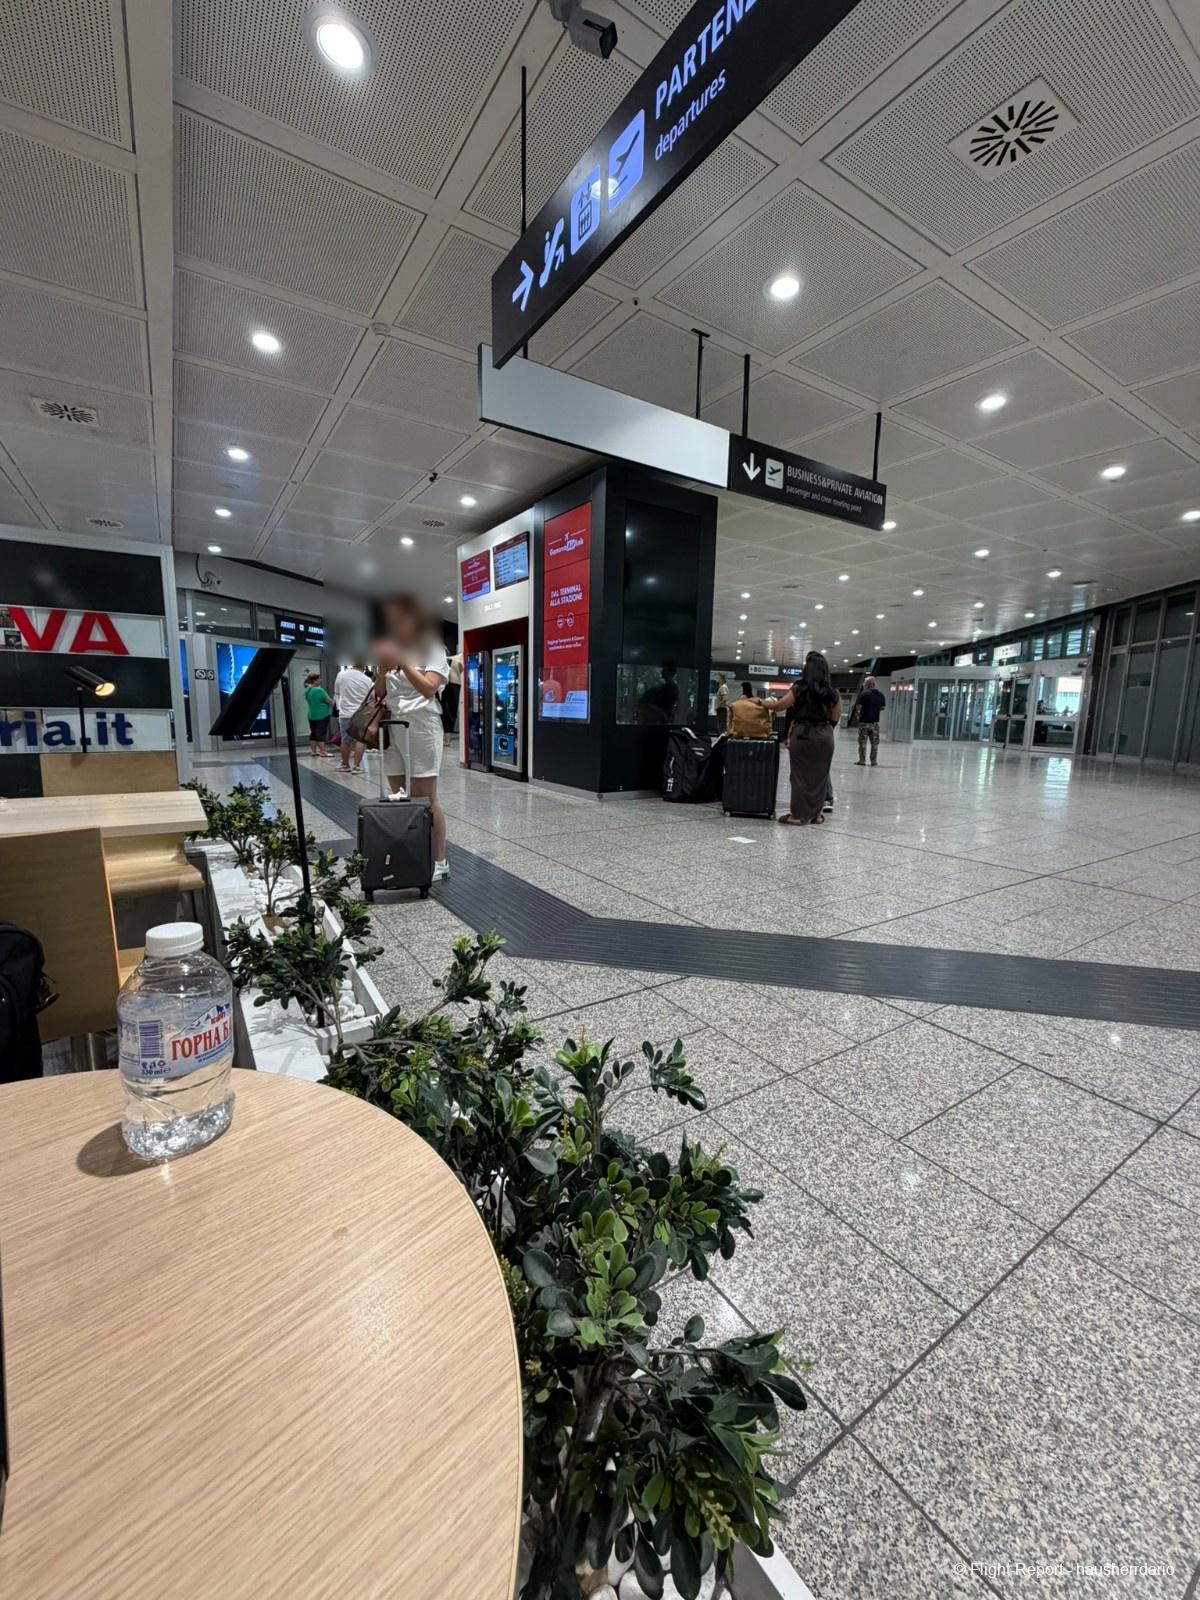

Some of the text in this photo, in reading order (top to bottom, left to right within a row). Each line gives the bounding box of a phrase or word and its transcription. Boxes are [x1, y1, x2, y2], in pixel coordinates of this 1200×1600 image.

[655, 69, 726, 161] departures
[787, 465, 883, 505] BUSINESS&PRIVATE AVIATION
[811, 492, 821, 501] and
[550, 592, 583, 607] ALLA STAZIONE
[560, 584, 581, 597] TERMINAL
[7, 606, 130, 655] VA
[0, 711, 134, 746] ria.it
[171, 1026, 221, 1061] ГОРНА
[154, 1067, 163, 1075] ml
